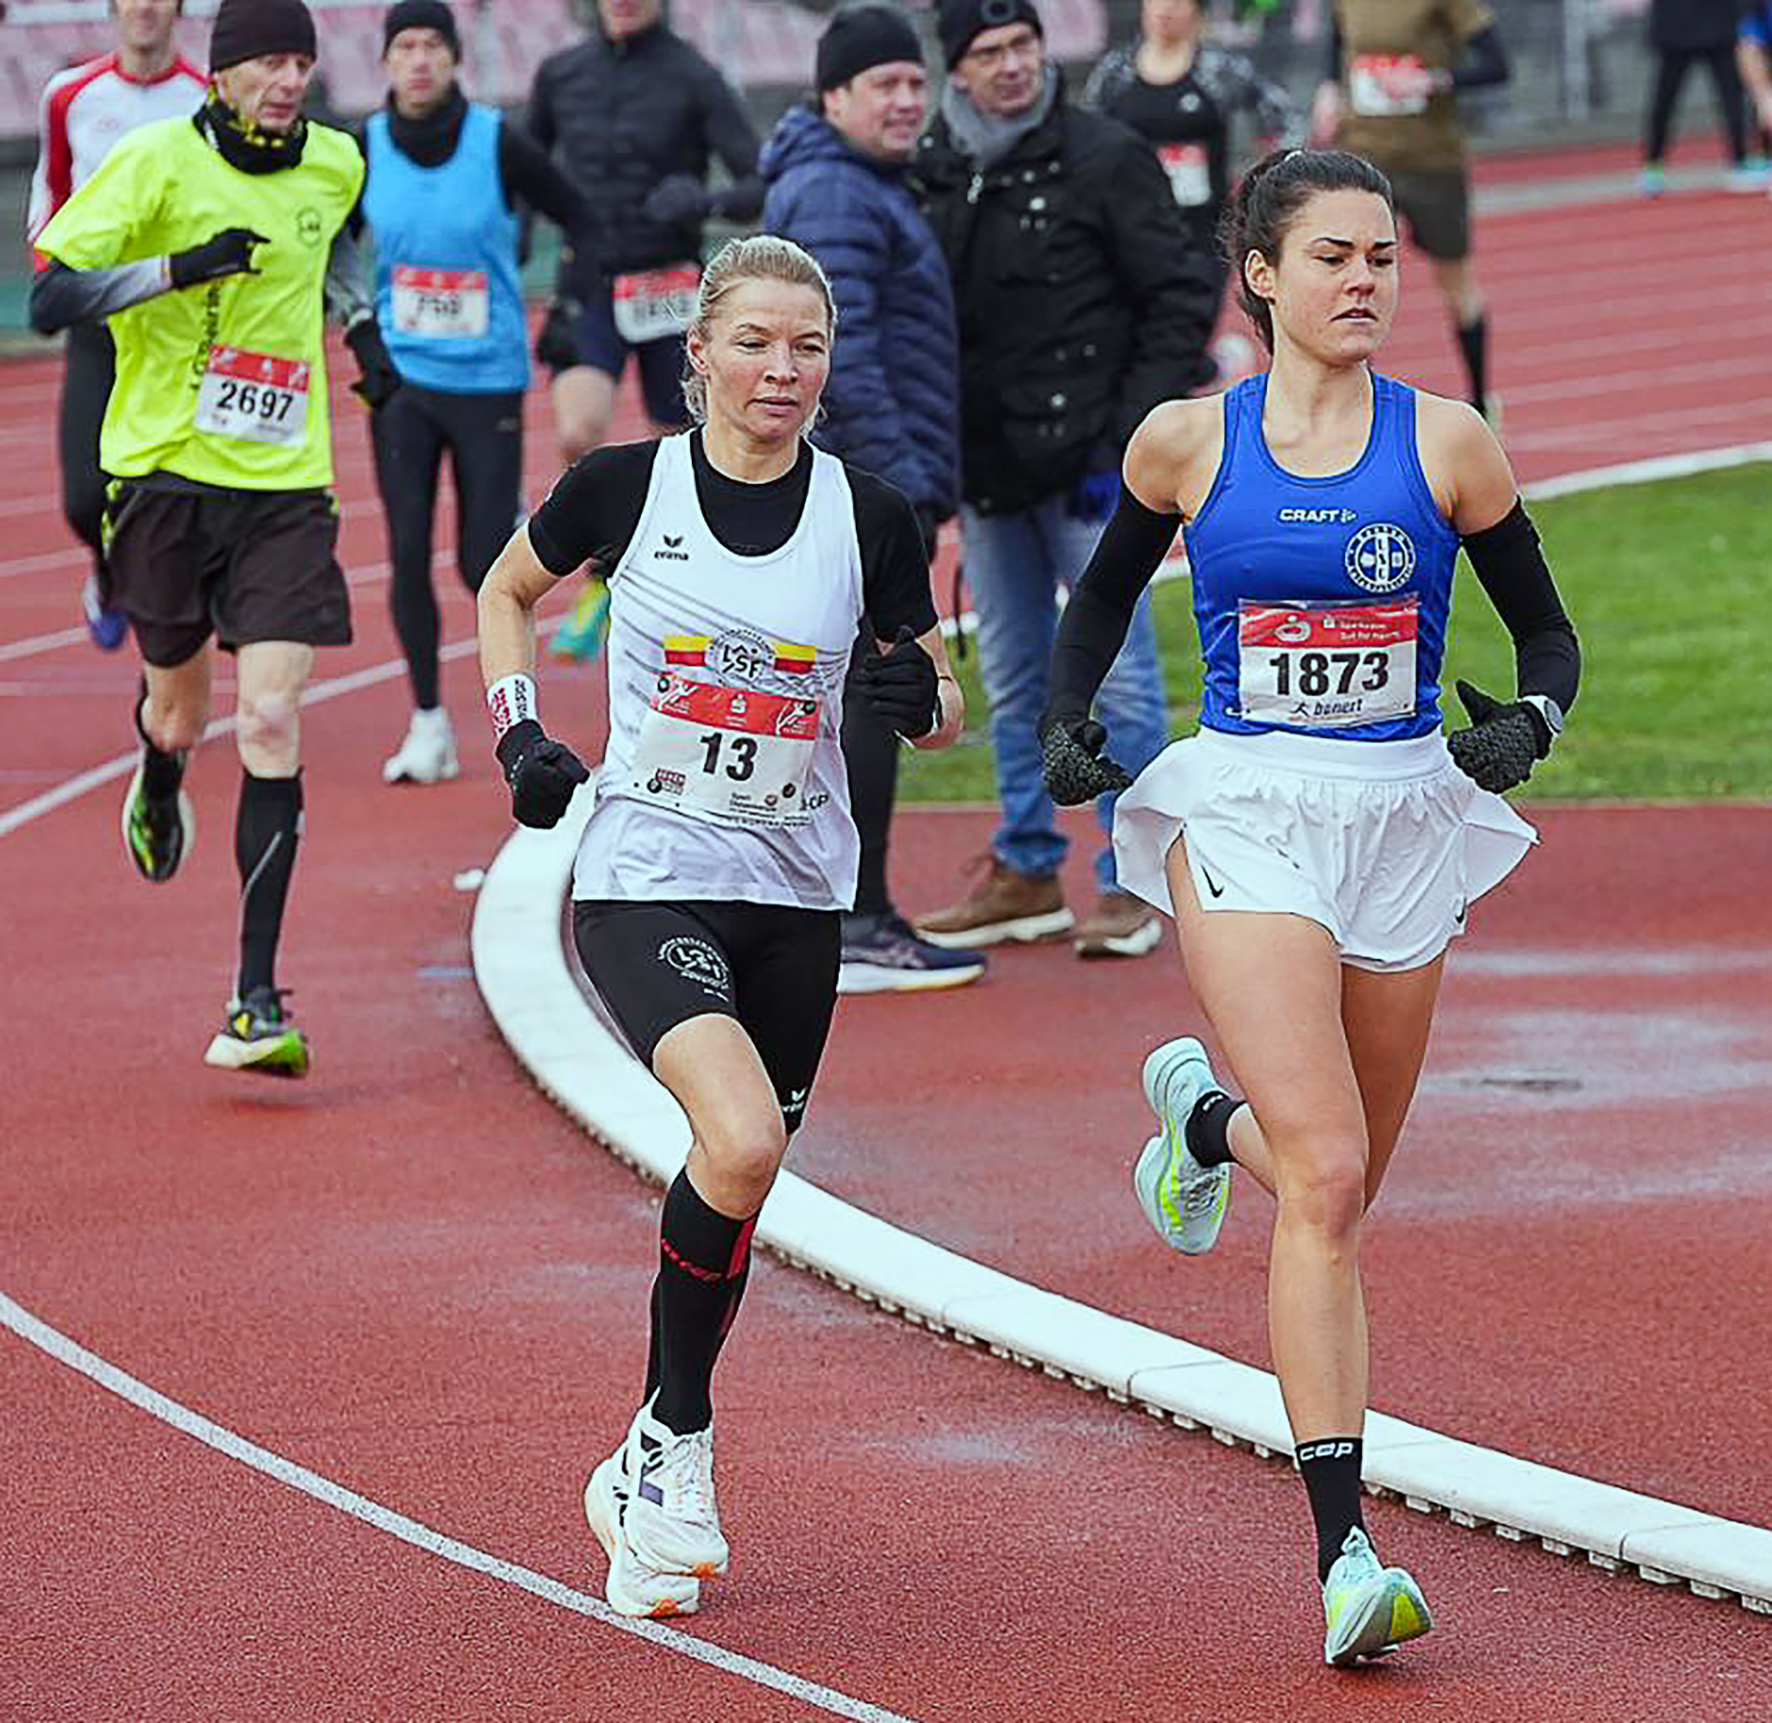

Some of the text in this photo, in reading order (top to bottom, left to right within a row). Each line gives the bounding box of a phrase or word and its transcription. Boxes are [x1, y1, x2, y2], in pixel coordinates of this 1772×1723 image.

[217, 379, 294, 422] 2697
[1280, 508, 1340, 523] CRAFT
[1269, 652, 1390, 697] 1873
[700, 731, 758, 782] 13
[1300, 1442, 1354, 1461] cep
